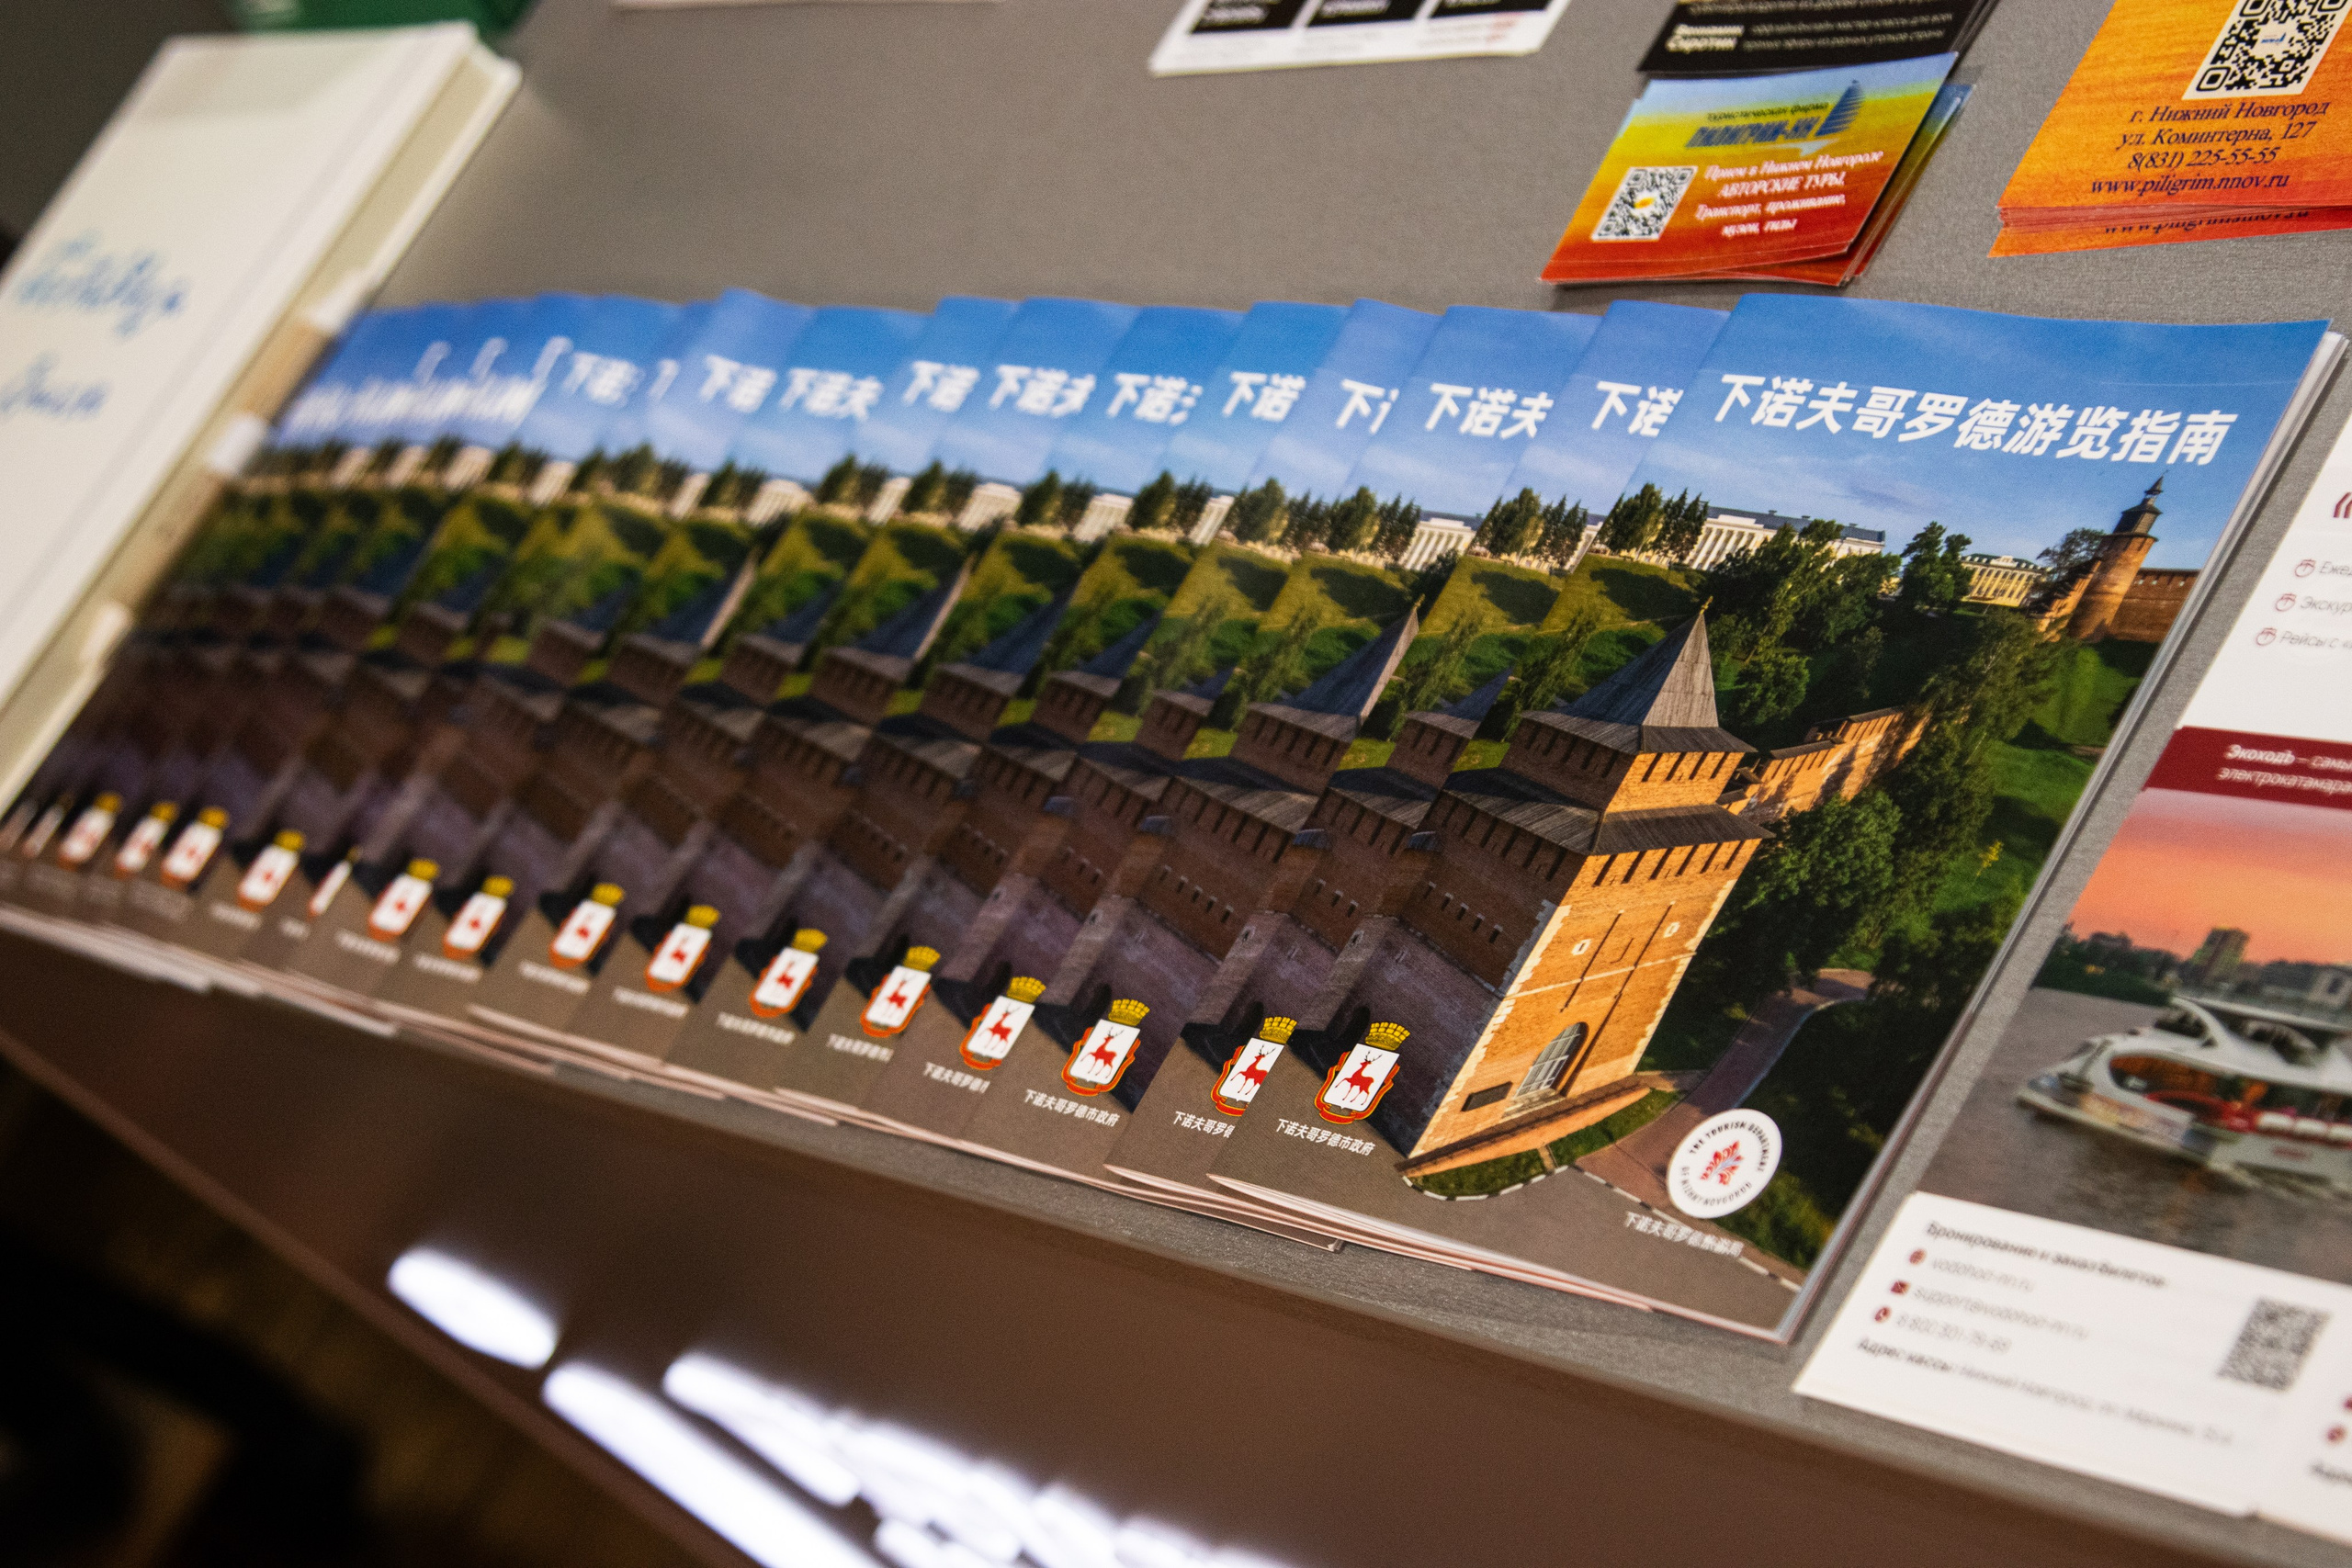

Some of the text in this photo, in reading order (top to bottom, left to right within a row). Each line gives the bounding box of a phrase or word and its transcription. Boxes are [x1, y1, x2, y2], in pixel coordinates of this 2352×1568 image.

[2128, 100, 2332, 124] г. Нижний Новгород
[2115, 120, 2318, 152] ул. Коминтерна, 127
[2185, 147, 2281, 168] 225-55-55
[2090, 173, 2290, 197] www.piligrim.nnov.ru
[1425, 382, 1555, 439] 下诺夫
[1713, 372, 2239, 467] 下诺夫哥罗德游览指南
[1274, 1117, 1376, 1156] 下诺夫哥罗德市政府
